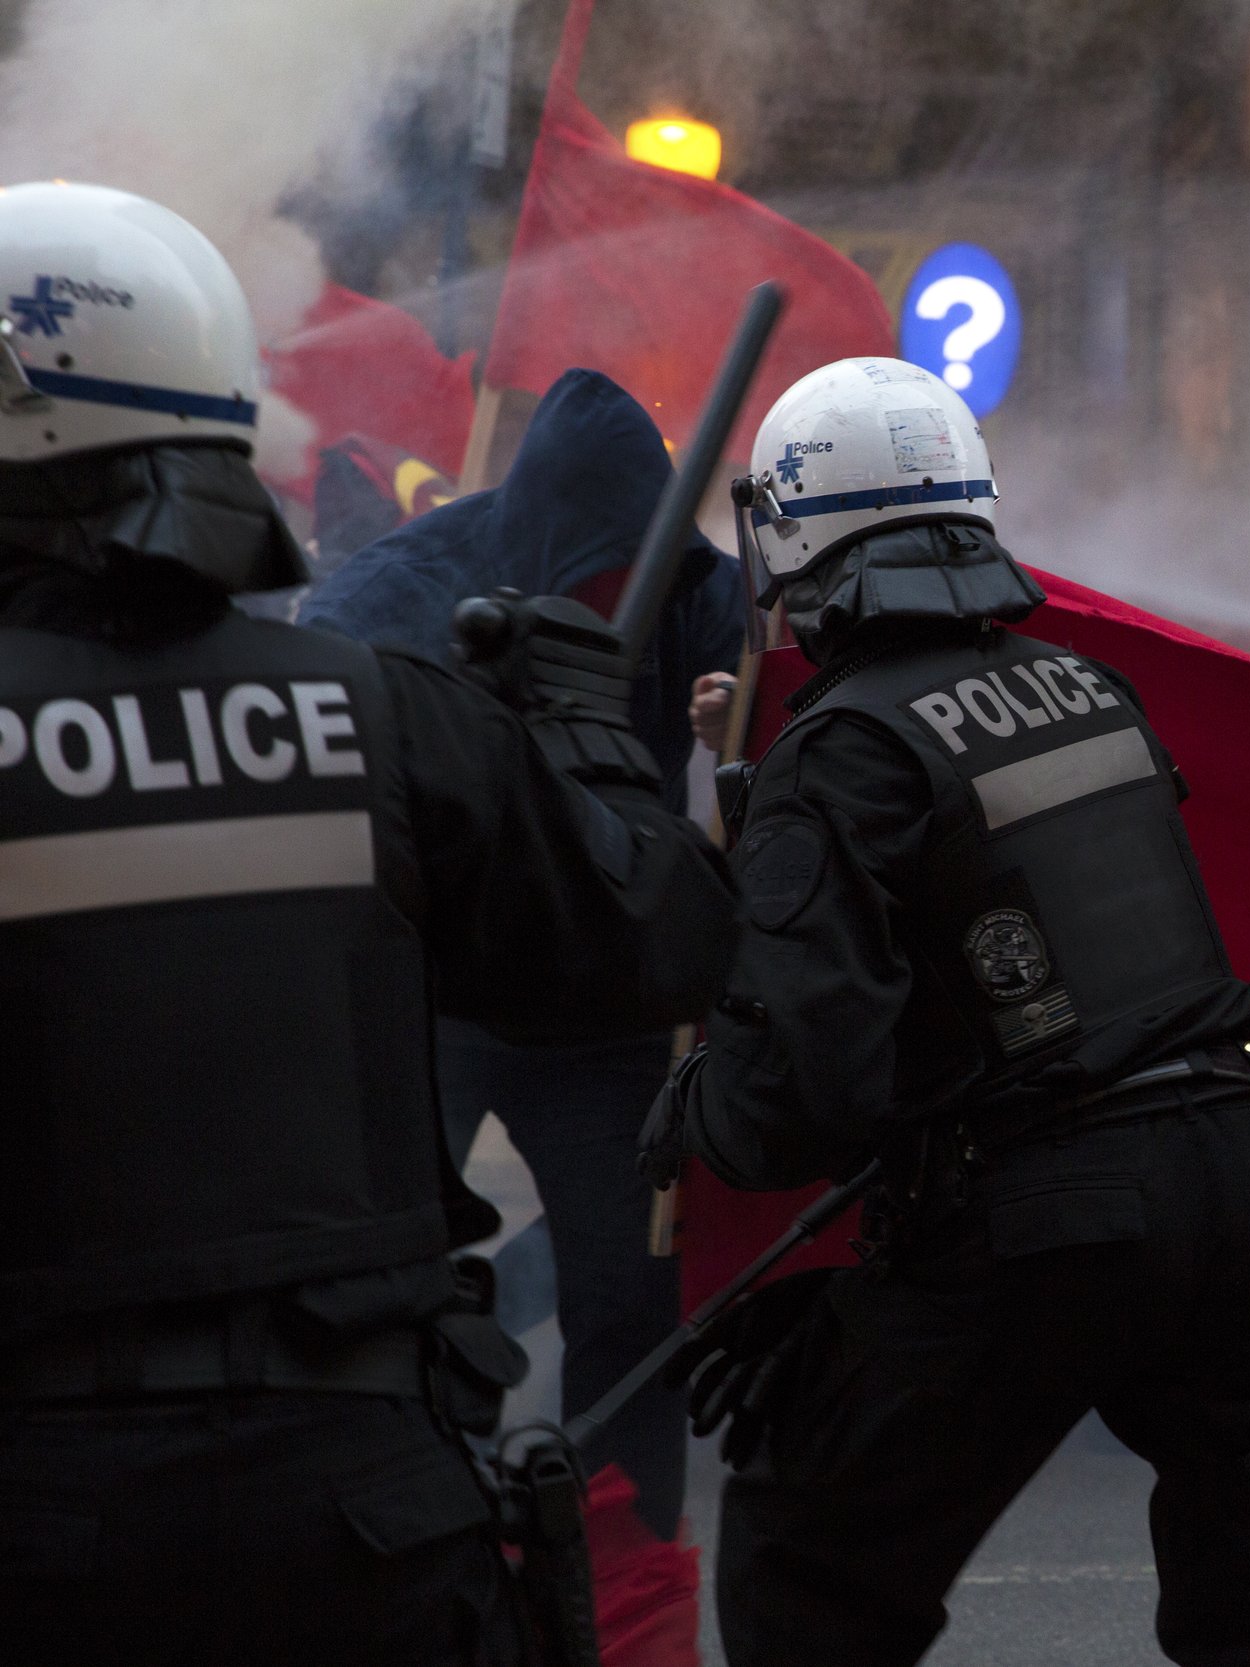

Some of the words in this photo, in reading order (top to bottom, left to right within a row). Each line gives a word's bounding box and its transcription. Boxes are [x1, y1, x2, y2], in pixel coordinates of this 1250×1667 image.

[55, 276, 136, 310] Police
[916, 274, 1006, 391] ?
[793, 440, 834, 457] Police
[909, 656, 1121, 756] POLICE
[984, 913, 1025, 926] MICHAEL
